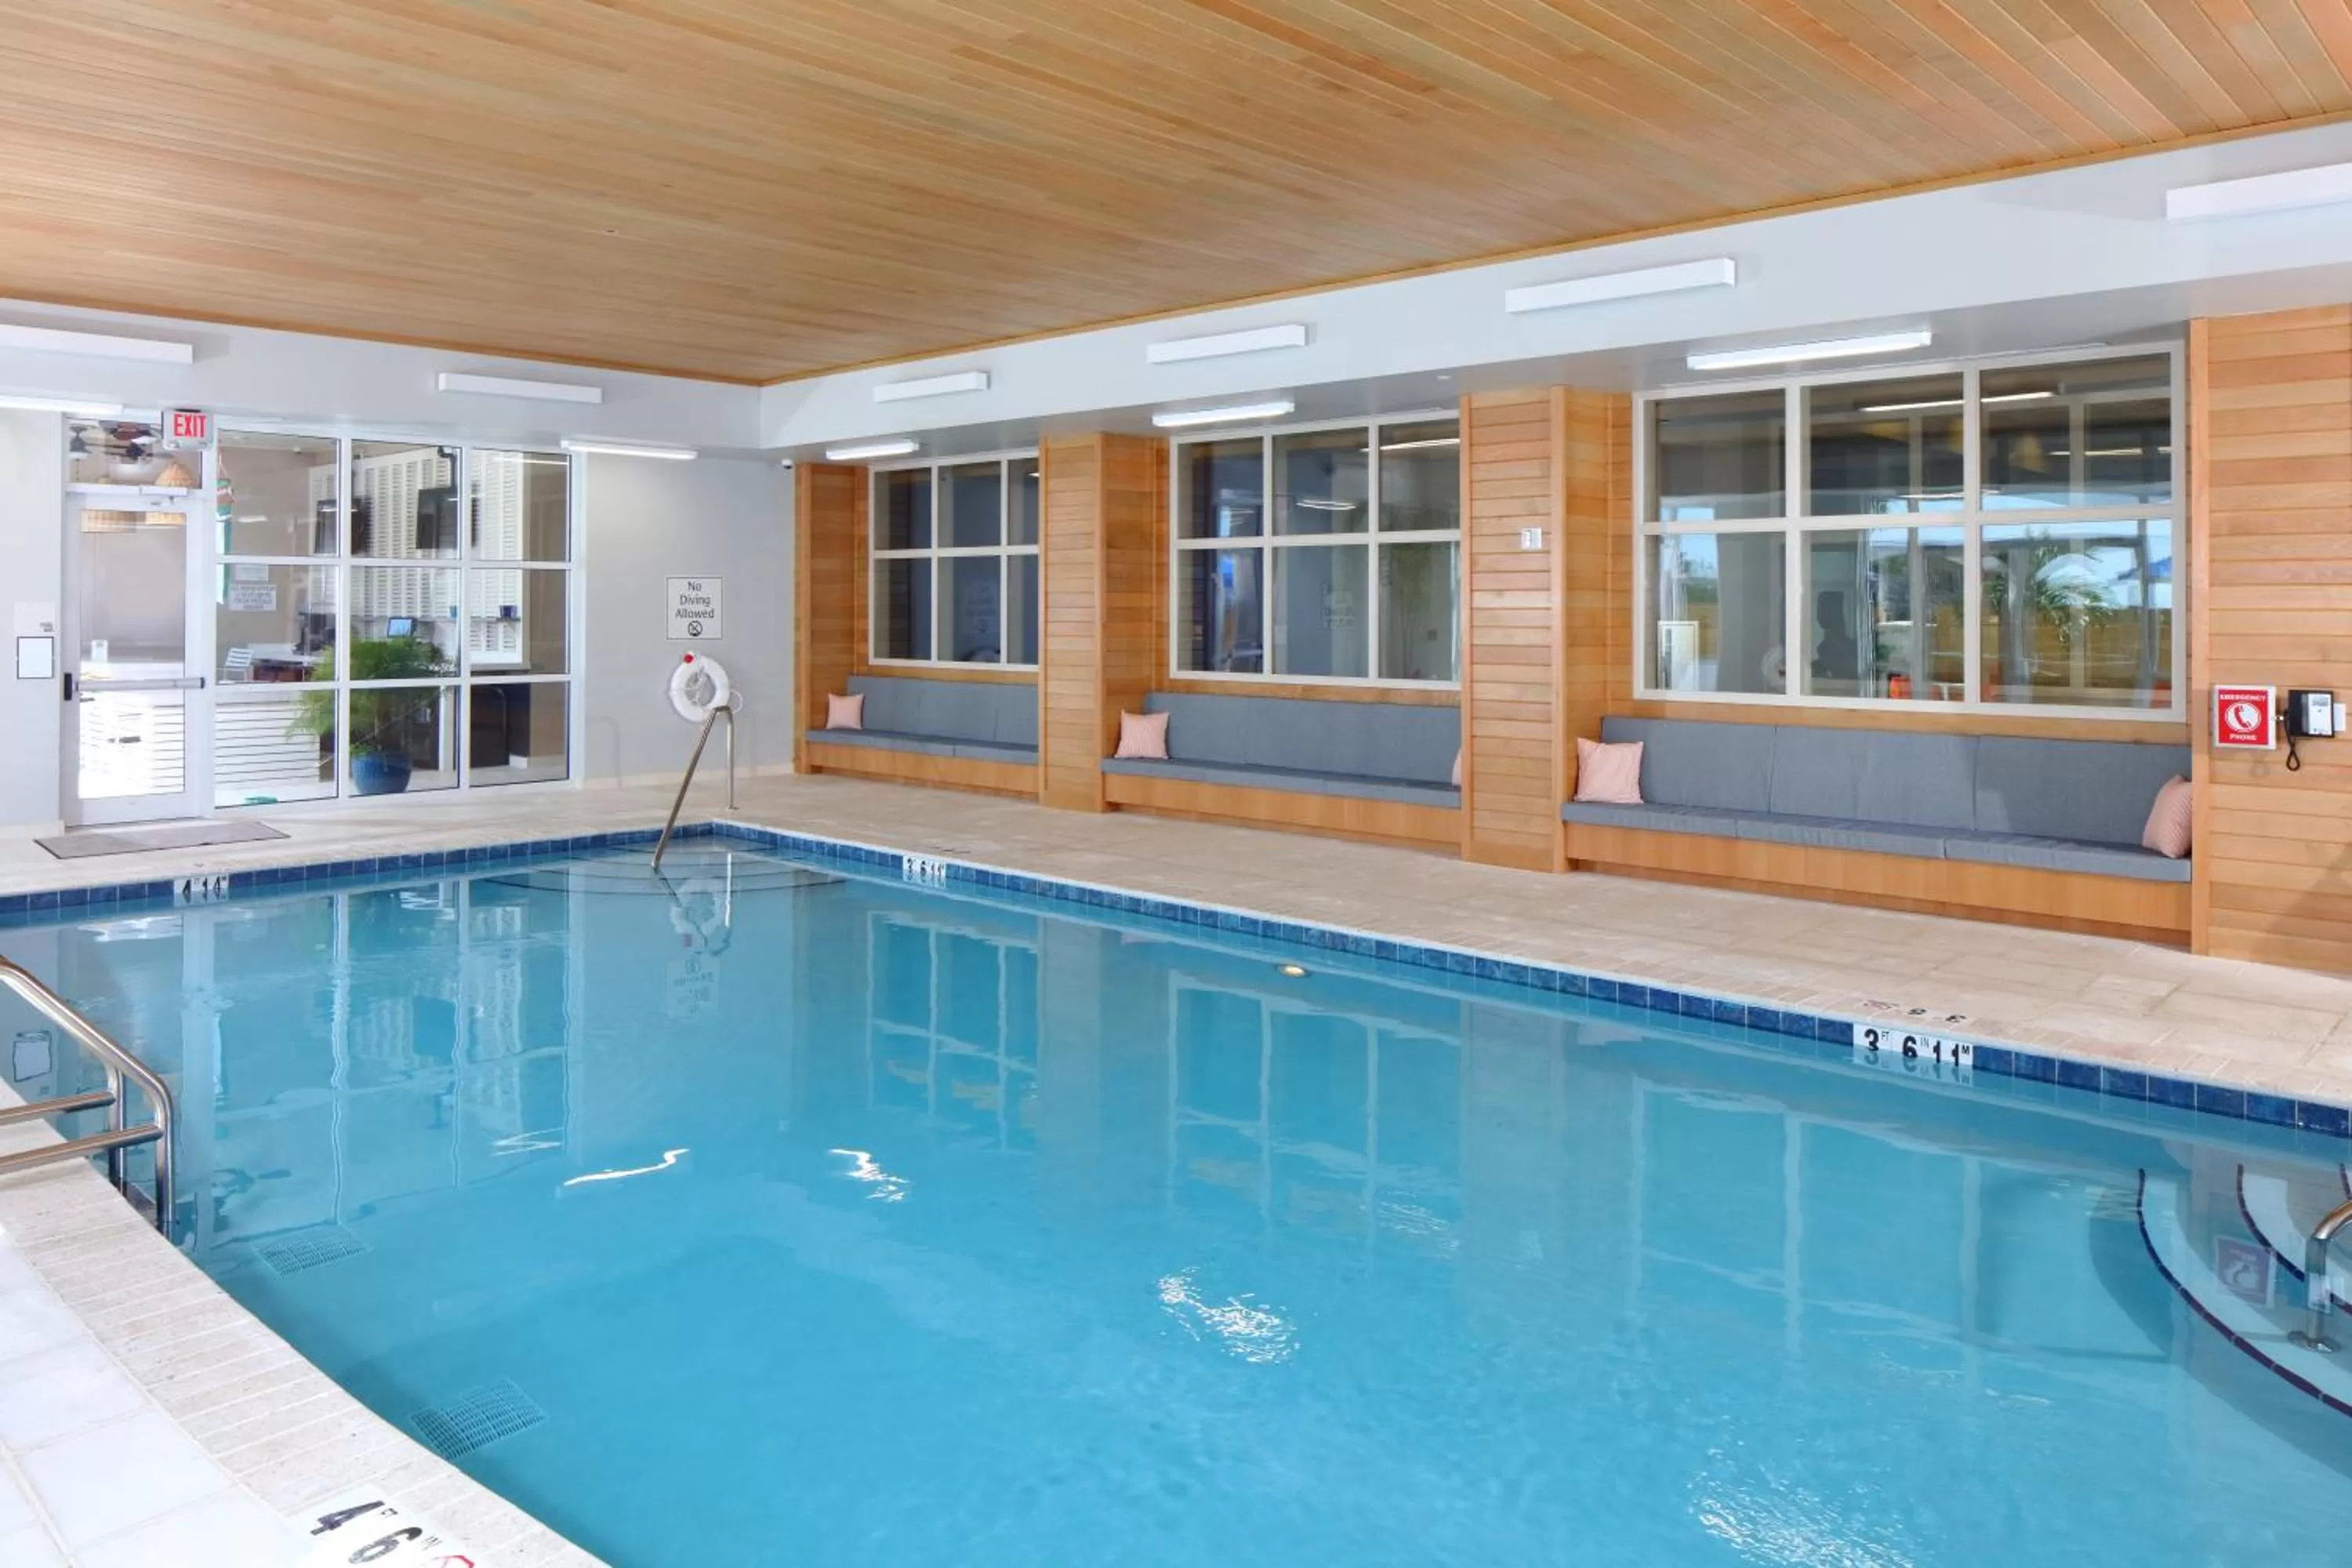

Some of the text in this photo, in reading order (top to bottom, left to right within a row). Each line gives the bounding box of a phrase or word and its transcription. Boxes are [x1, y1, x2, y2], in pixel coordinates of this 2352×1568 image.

[174, 413, 207, 437] EXIT
[688, 581, 702, 591] No
[680, 594, 711, 608] Diving
[676, 608, 715, 619] Allowed
